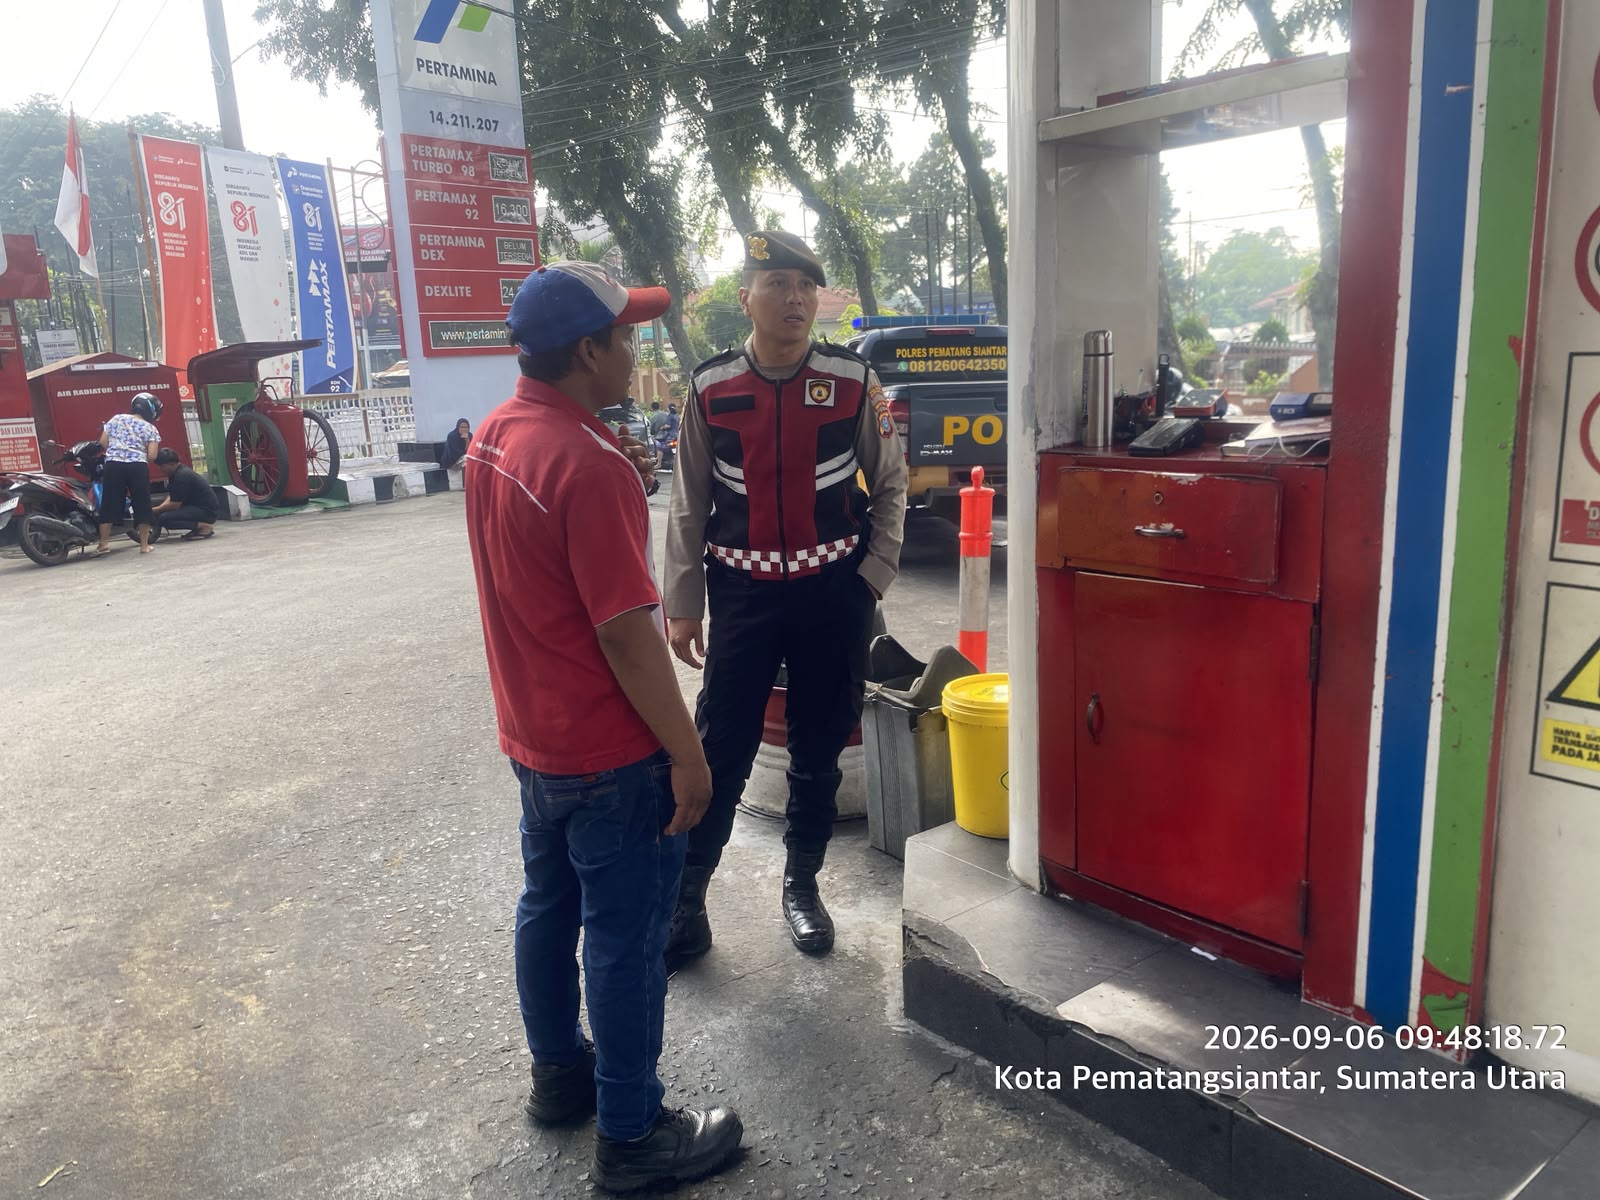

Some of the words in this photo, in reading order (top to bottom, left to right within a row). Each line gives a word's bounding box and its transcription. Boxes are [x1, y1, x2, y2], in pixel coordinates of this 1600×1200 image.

[416, 57, 498, 86] PERTAMINA
[429, 110, 500, 132] 14.211.207
[410, 143, 473, 162] PERTAMAX
[412, 159, 453, 175] TURBO
[461, 165, 476, 177] 98
[415, 189, 478, 206] PERTAMAX
[158, 192, 186, 231] 81
[302, 202, 323, 232] 81
[464, 208, 480, 220] 92
[495, 203, 529, 217] 16.300
[231, 200, 258, 237] 81
[419, 233, 486, 249] PERTAMINA
[503, 241, 527, 250] BELUM
[421, 248, 446, 261] DEX
[424, 285, 472, 298] DEXLITE
[502, 286, 522, 298] 24
[320, 259, 336, 369] PERTAMAX
[441, 328, 508, 342] www.pertamin
[896, 348, 927, 358] POLRES
[928, 346, 971, 357] PEMATANG
[973, 345, 1007, 356] SIANTAR
[909, 358, 1006, 373] 081260642350
[57, 390, 72, 398] AIR
[73, 387, 113, 397] RADIATOR
[116, 384, 148, 393] ANGIN
[943, 414, 1008, 446] PO
[1552, 745, 1583, 760] PADA
